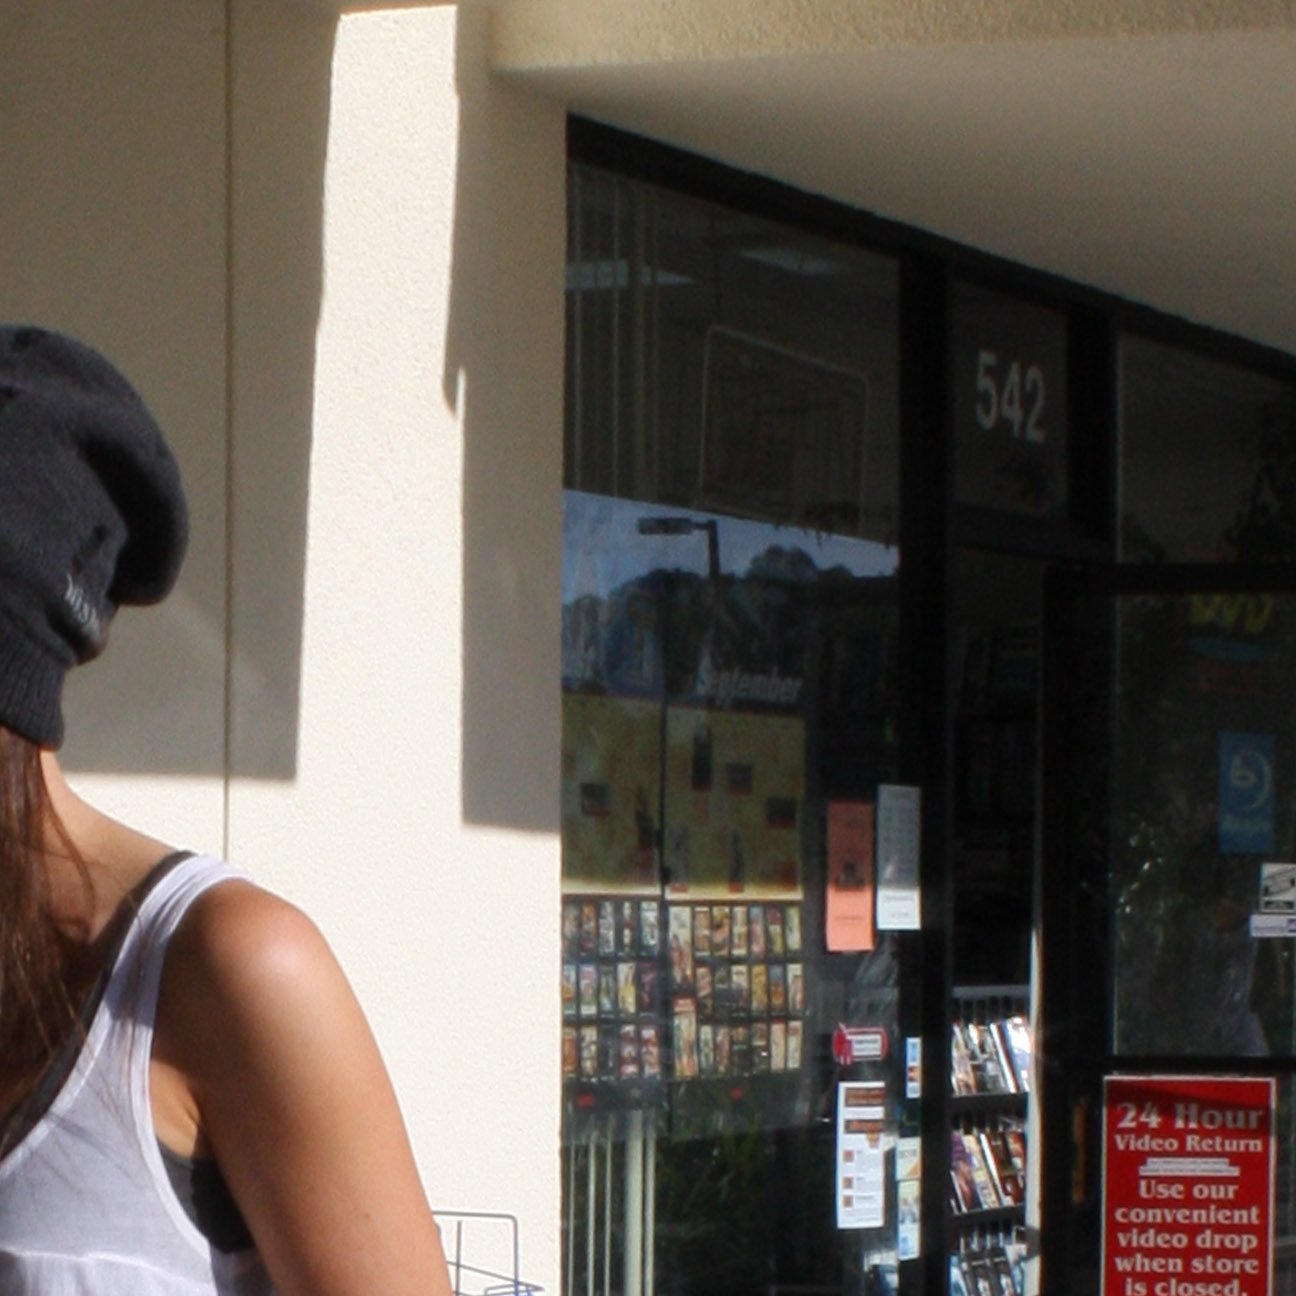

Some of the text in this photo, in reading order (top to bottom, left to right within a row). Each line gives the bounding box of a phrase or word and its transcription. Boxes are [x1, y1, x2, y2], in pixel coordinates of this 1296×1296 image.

[976, 350, 1045, 443] 542
[1116, 1102, 1263, 1130] 24 Hour
[1114, 1134, 1263, 1152] Video Return
[1138, 1179, 1239, 1200] Use our
[1114, 1204, 1260, 1225] convenient
[1116, 1228, 1258, 1254] video drop
[1114, 1252, 1259, 1275] when store
[1124, 1277, 1147, 1296] is
